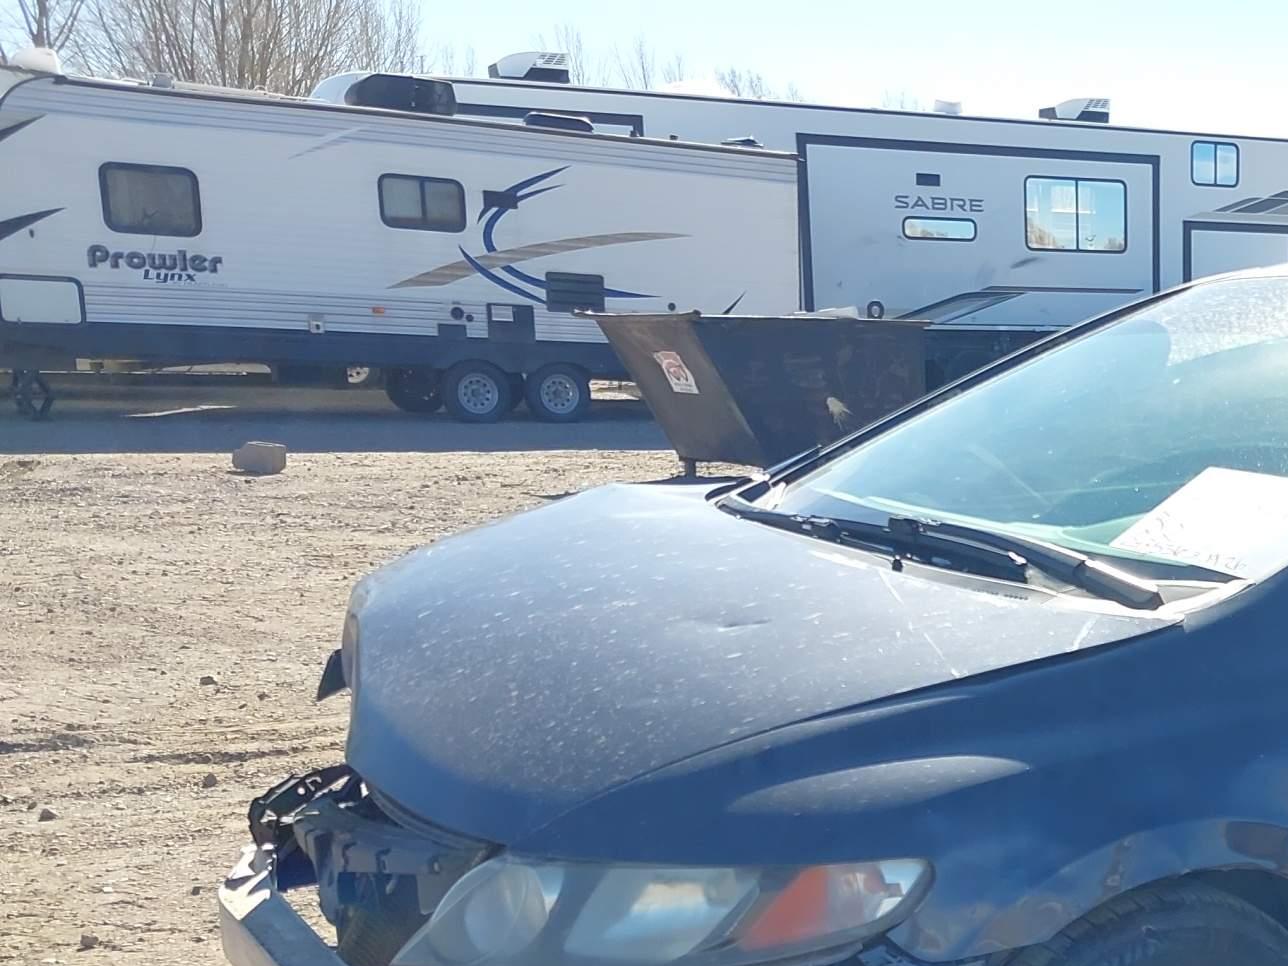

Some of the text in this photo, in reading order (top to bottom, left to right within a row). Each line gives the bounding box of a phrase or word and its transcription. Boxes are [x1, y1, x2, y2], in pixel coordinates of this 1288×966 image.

[894, 195, 985, 213] SABRE
[87, 244, 223, 274] Prowler
[143, 269, 197, 284] Lynx
